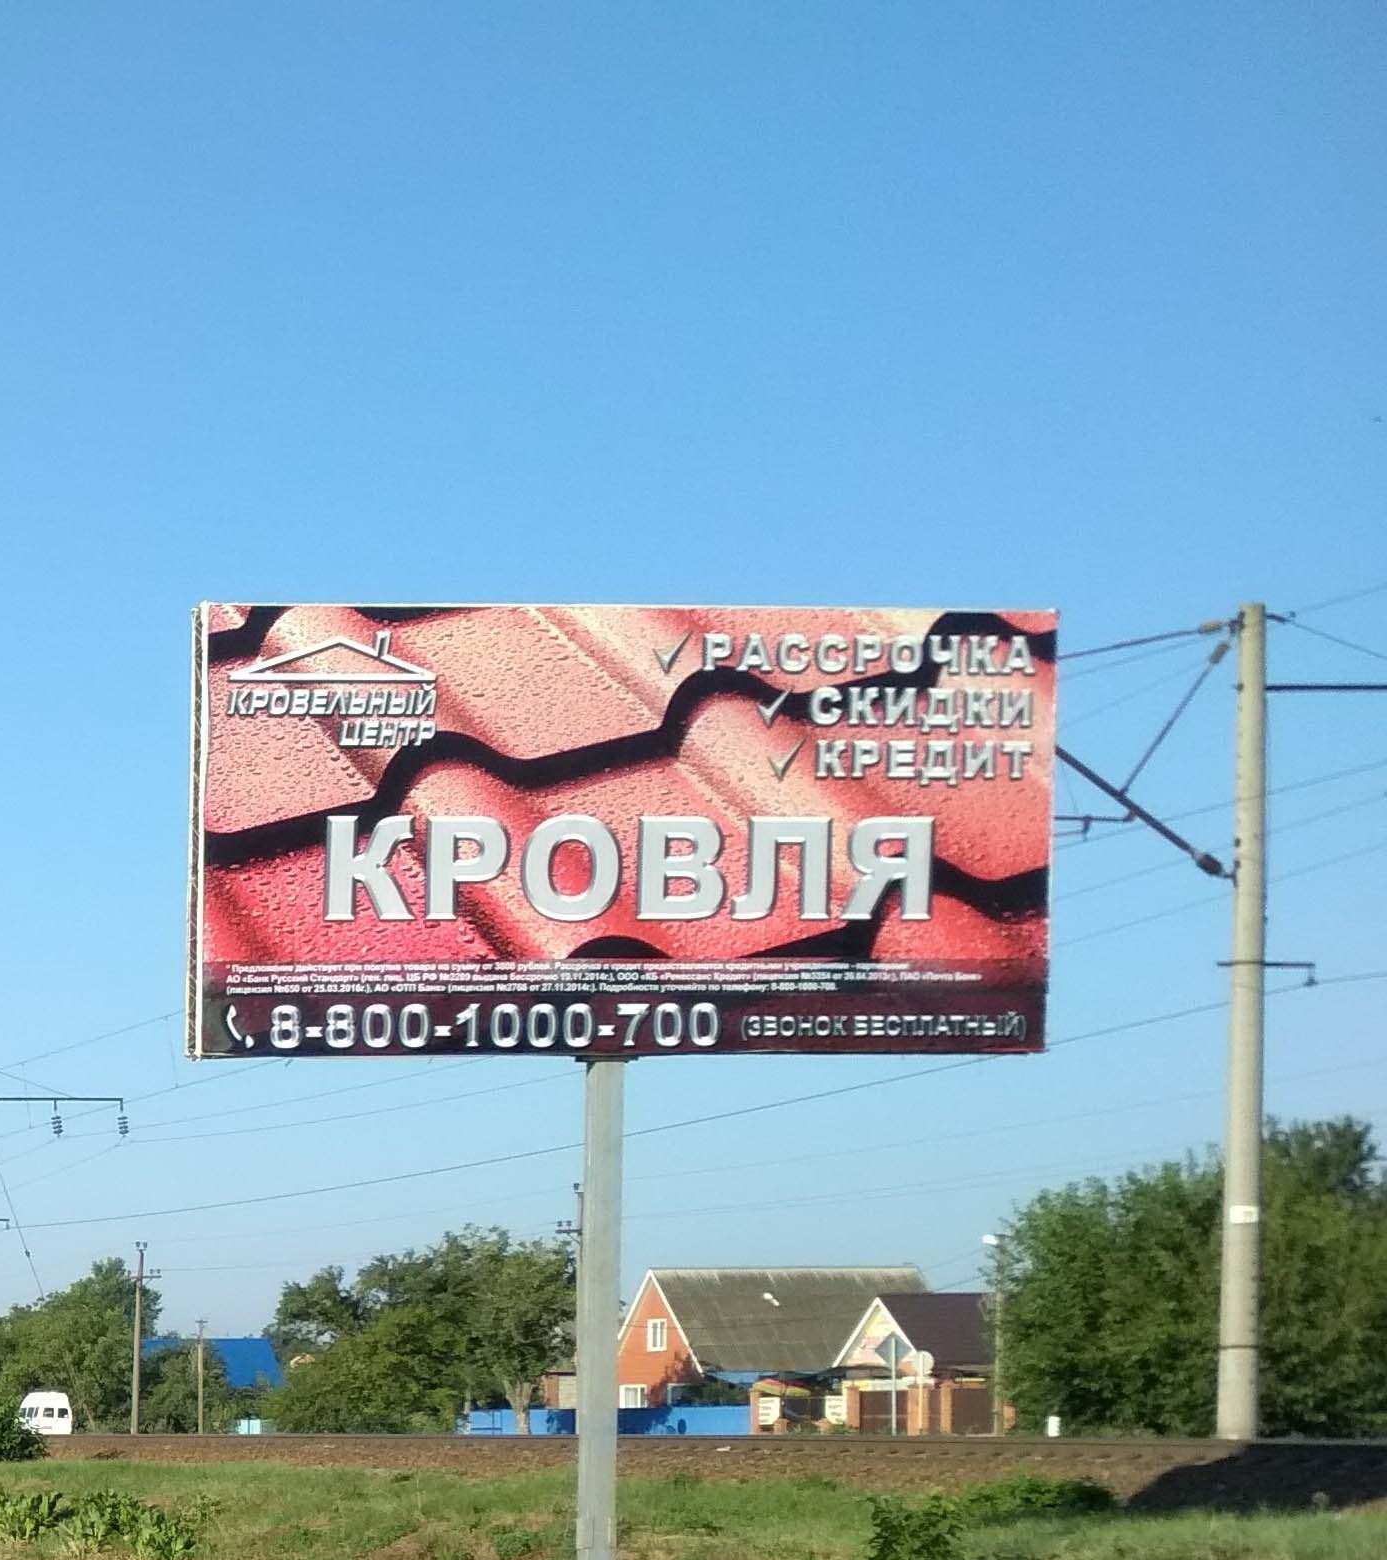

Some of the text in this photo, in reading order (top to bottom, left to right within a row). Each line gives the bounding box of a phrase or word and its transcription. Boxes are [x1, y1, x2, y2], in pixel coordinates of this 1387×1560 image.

[702, 632, 1036, 675] РАССРОЧКА
[227, 684, 437, 717] КРОВЕЛЬНЫЙ
[809, 686, 1033, 733] СКИДКИ
[339, 719, 437, 748] ЦЕНТР
[814, 739, 1033, 786] КРЕДИТ
[324, 814, 935, 922] КРОВЛЯ
[226, 974, 240, 982] АО
[271, 974, 308, 983] Русский
[422, 973, 438, 981] РФ
[617, 973, 639, 981] ООО
[374, 984, 389, 992] АО
[270, 1003, 1026, 1049] 8-800-1000-700 (ЗВОНОК БЕСПЛАТНЫЙ)
